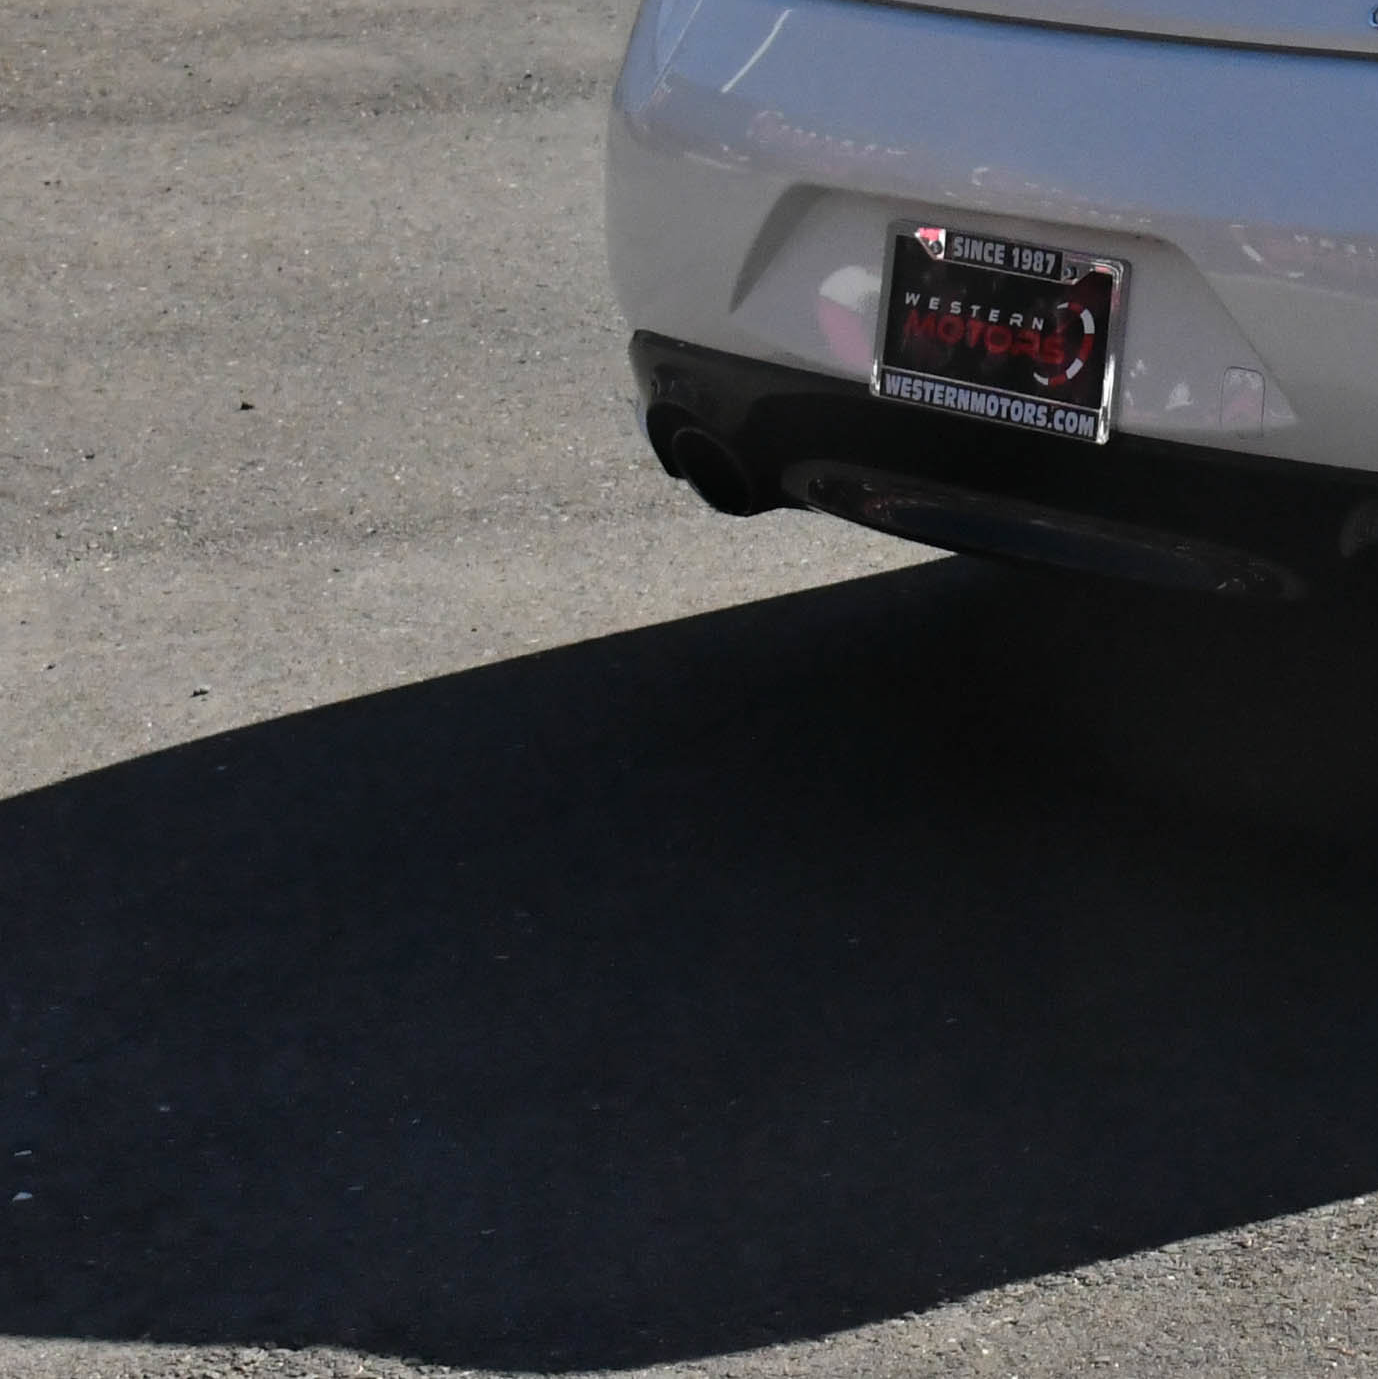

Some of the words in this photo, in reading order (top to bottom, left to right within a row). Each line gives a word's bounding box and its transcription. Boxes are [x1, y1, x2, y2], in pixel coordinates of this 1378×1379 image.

[953, 236, 1005, 265] SINCE
[1012, 247, 1056, 275] 1987
[905, 292, 1043, 330] WESTERN
[903, 309, 1065, 364] MOTORS
[885, 373, 1095, 437] WESTERNMOTORS.COM
